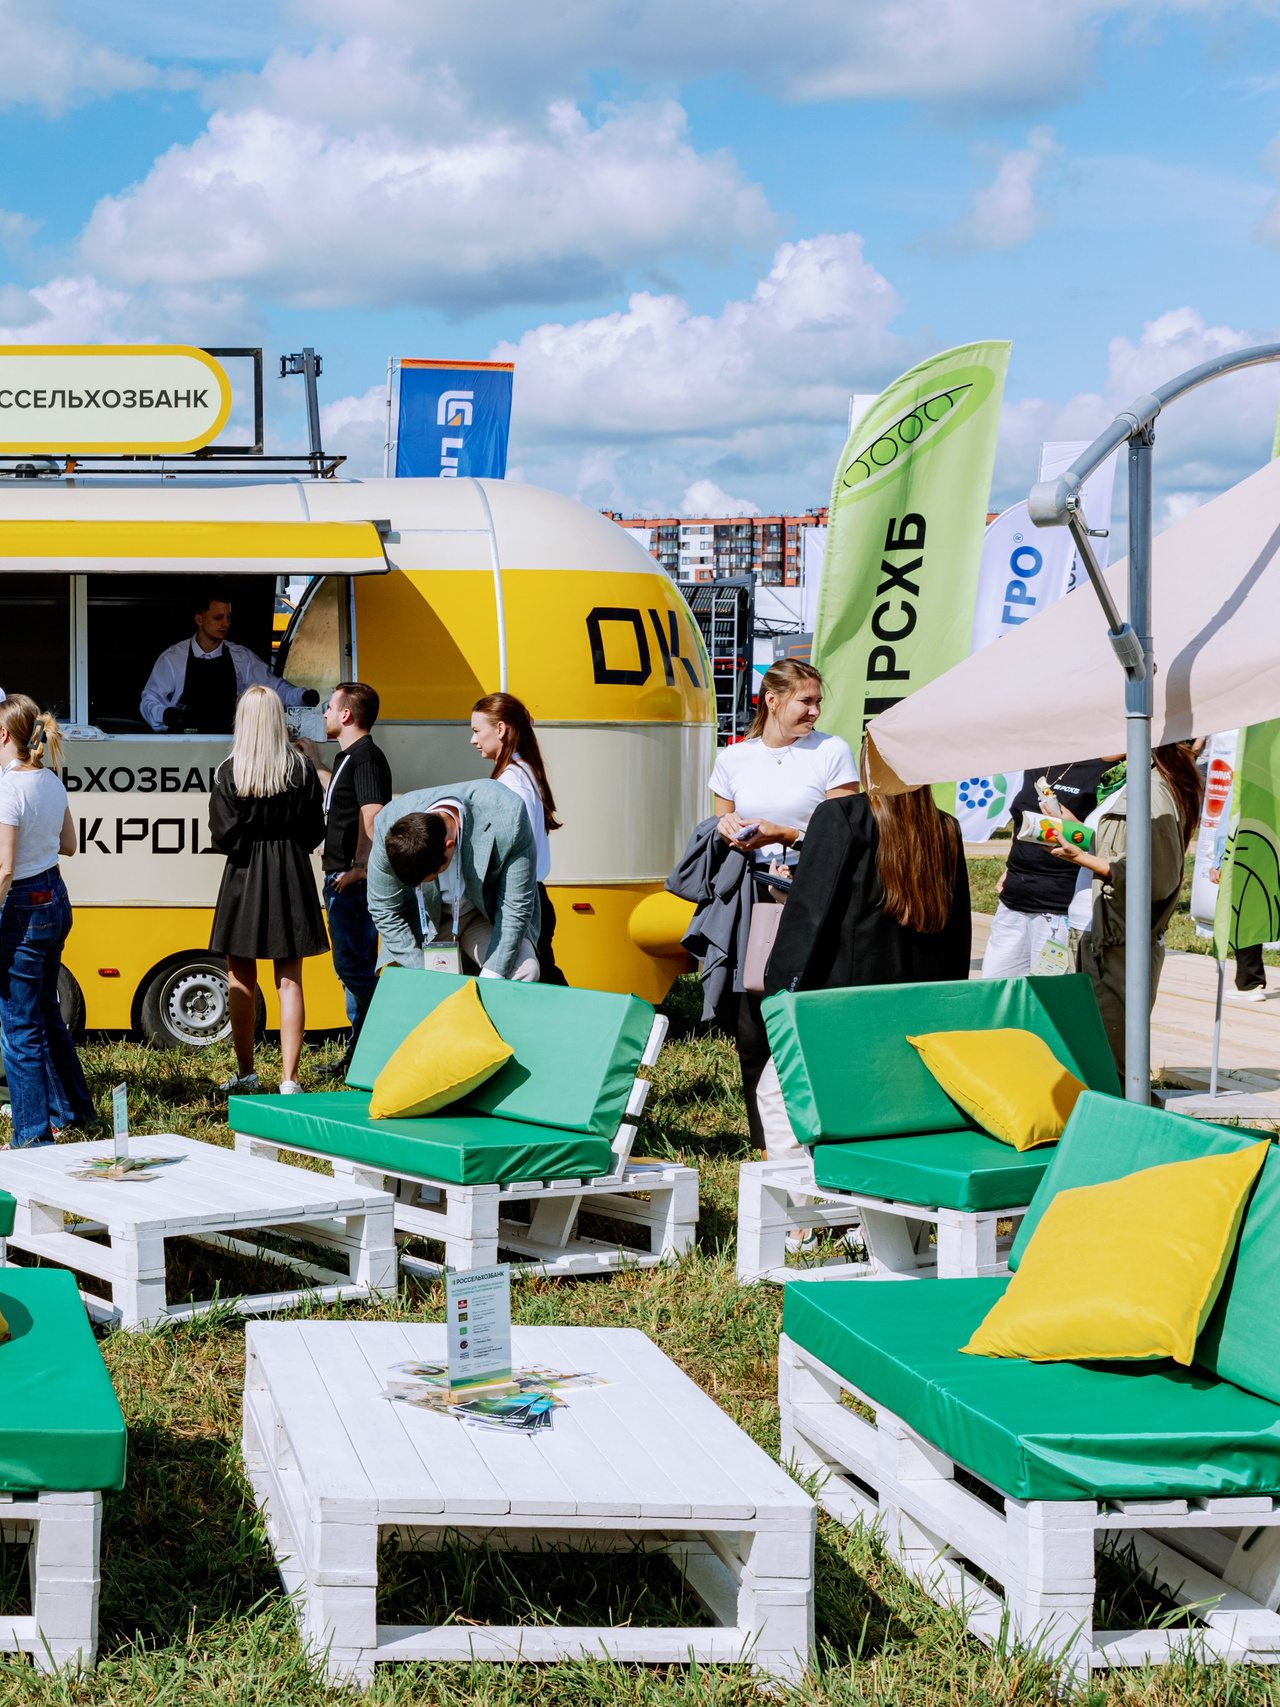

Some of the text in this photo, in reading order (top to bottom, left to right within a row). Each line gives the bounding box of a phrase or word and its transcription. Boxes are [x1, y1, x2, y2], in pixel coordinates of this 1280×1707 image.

[866, 512, 927, 681] РСХБ
[999, 545, 1043, 637] ГРО
[586, 607, 709, 689] ОК
[456, 1271, 504, 1284] РОССЕЛЬХОЗБАНК
